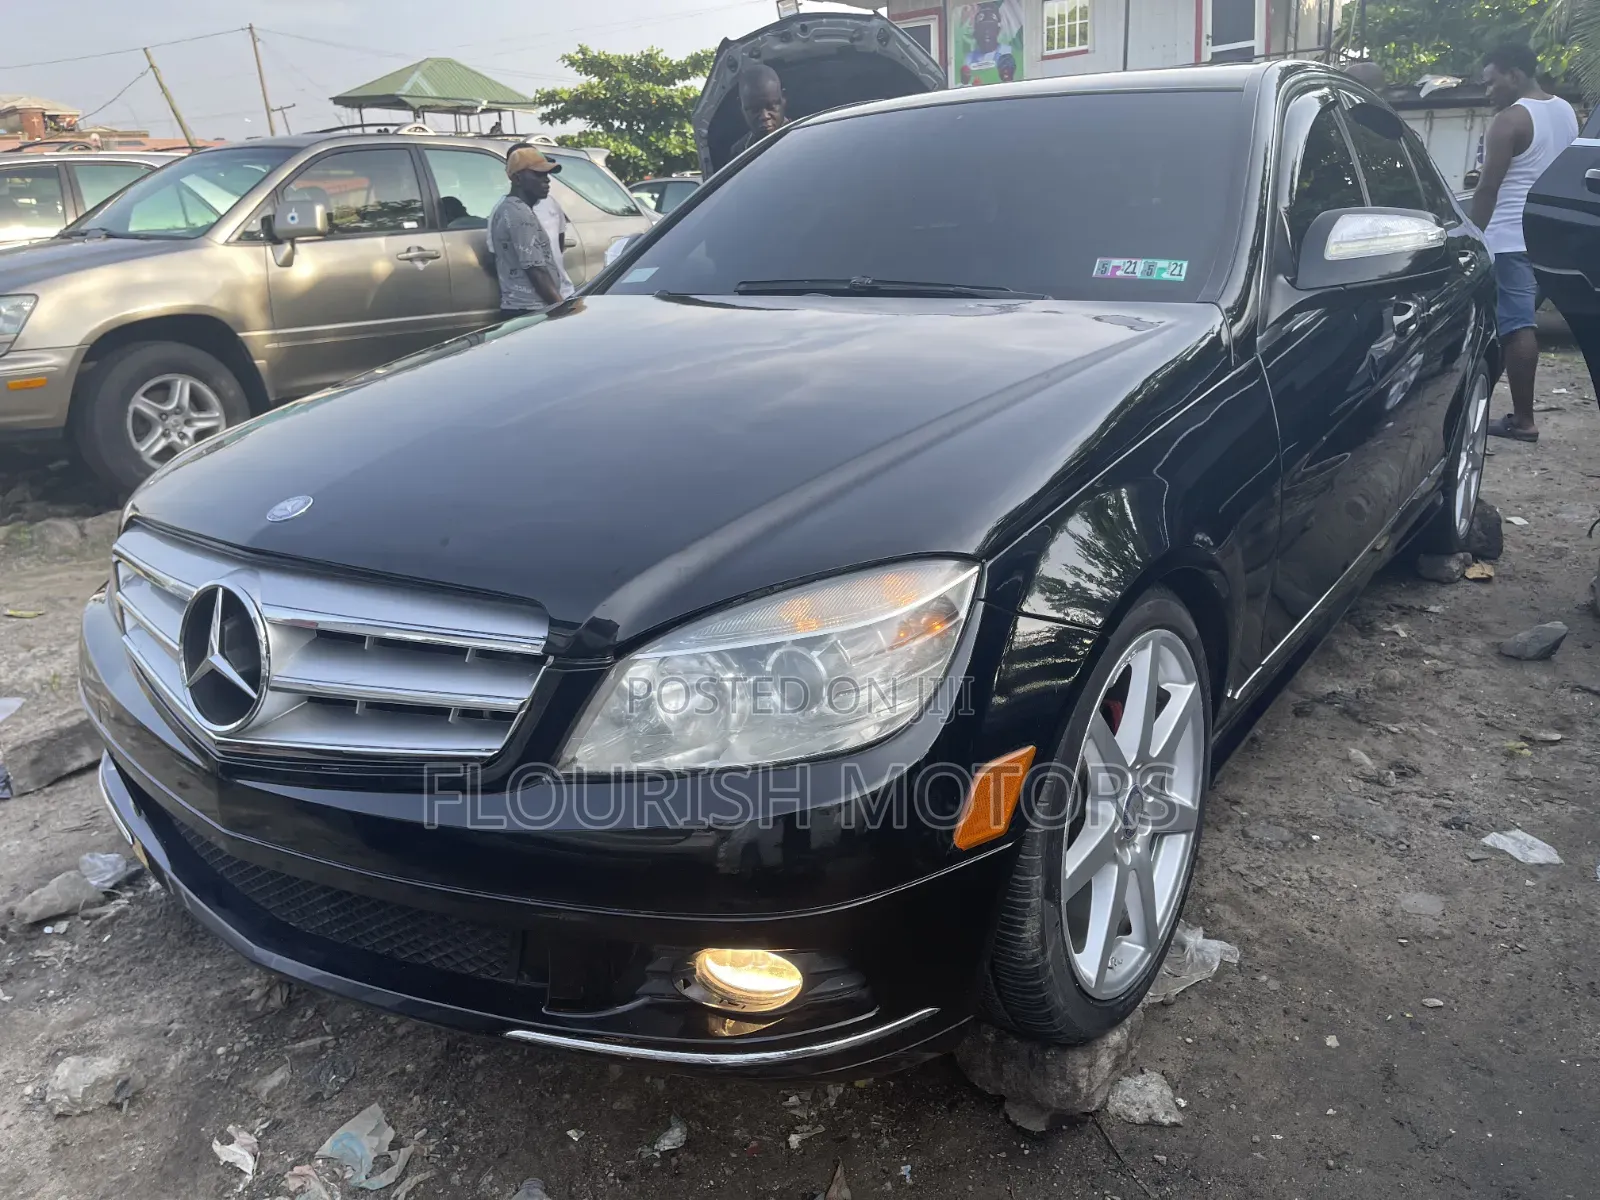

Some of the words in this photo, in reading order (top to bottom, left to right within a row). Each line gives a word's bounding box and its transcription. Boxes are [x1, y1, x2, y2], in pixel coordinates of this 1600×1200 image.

[1101, 263, 1108, 275] 5
[1124, 260, 1138, 275] 21
[1147, 264, 1154, 276] 5
[1170, 262, 1183, 277] 21
